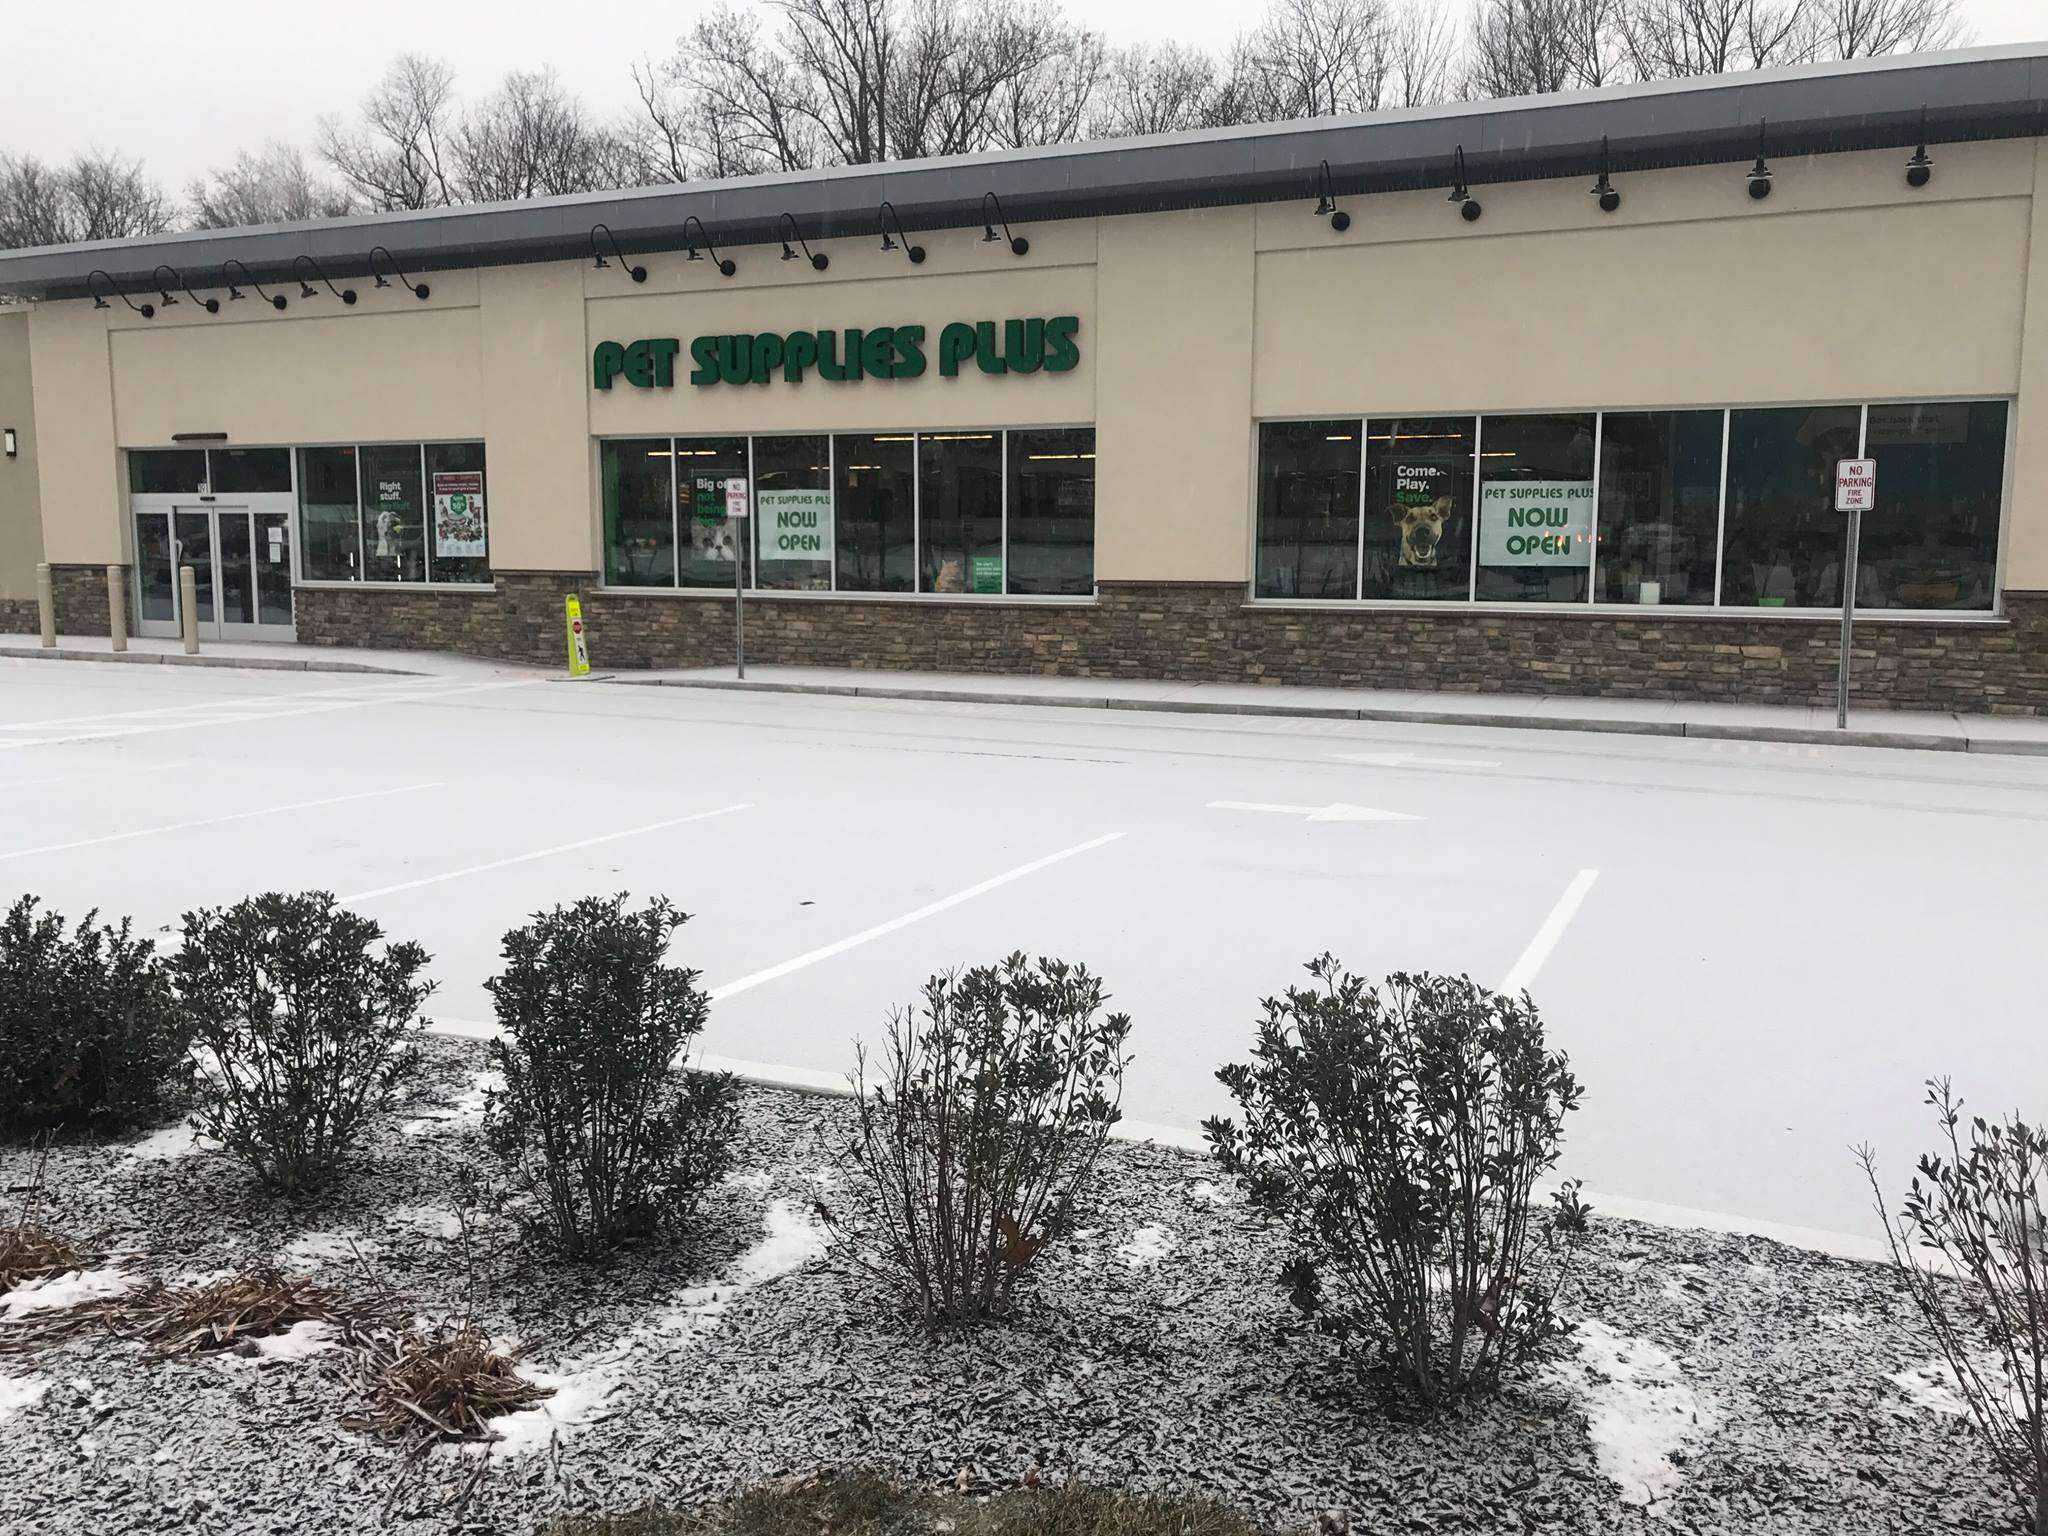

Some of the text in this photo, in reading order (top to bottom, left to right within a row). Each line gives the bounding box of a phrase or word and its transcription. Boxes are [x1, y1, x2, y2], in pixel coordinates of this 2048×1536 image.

[593, 315, 1080, 390] PET SUPPLIES PLUS
[1397, 465, 1441, 477] Come.
[1849, 465, 1863, 476] NO
[379, 481, 401, 493] Right
[696, 478, 715, 492] Big
[1396, 478, 1430, 492] Play.
[1838, 477, 1873, 488] PARKING
[380, 491, 402, 501] stuff.
[1396, 491, 1432, 503] Save.
[1484, 488, 1506, 499] PET
[1510, 487, 1563, 499] SUPPLIES
[1847, 489, 1863, 497] FIRE
[760, 495, 831, 505] PET SUPPLIES PLU
[1845, 497, 1863, 505] ZONE
[777, 511, 818, 529] NOW
[1507, 507, 1569, 528] NOW
[778, 534, 821, 552] OPEN
[1506, 535, 1571, 555] OPEN
